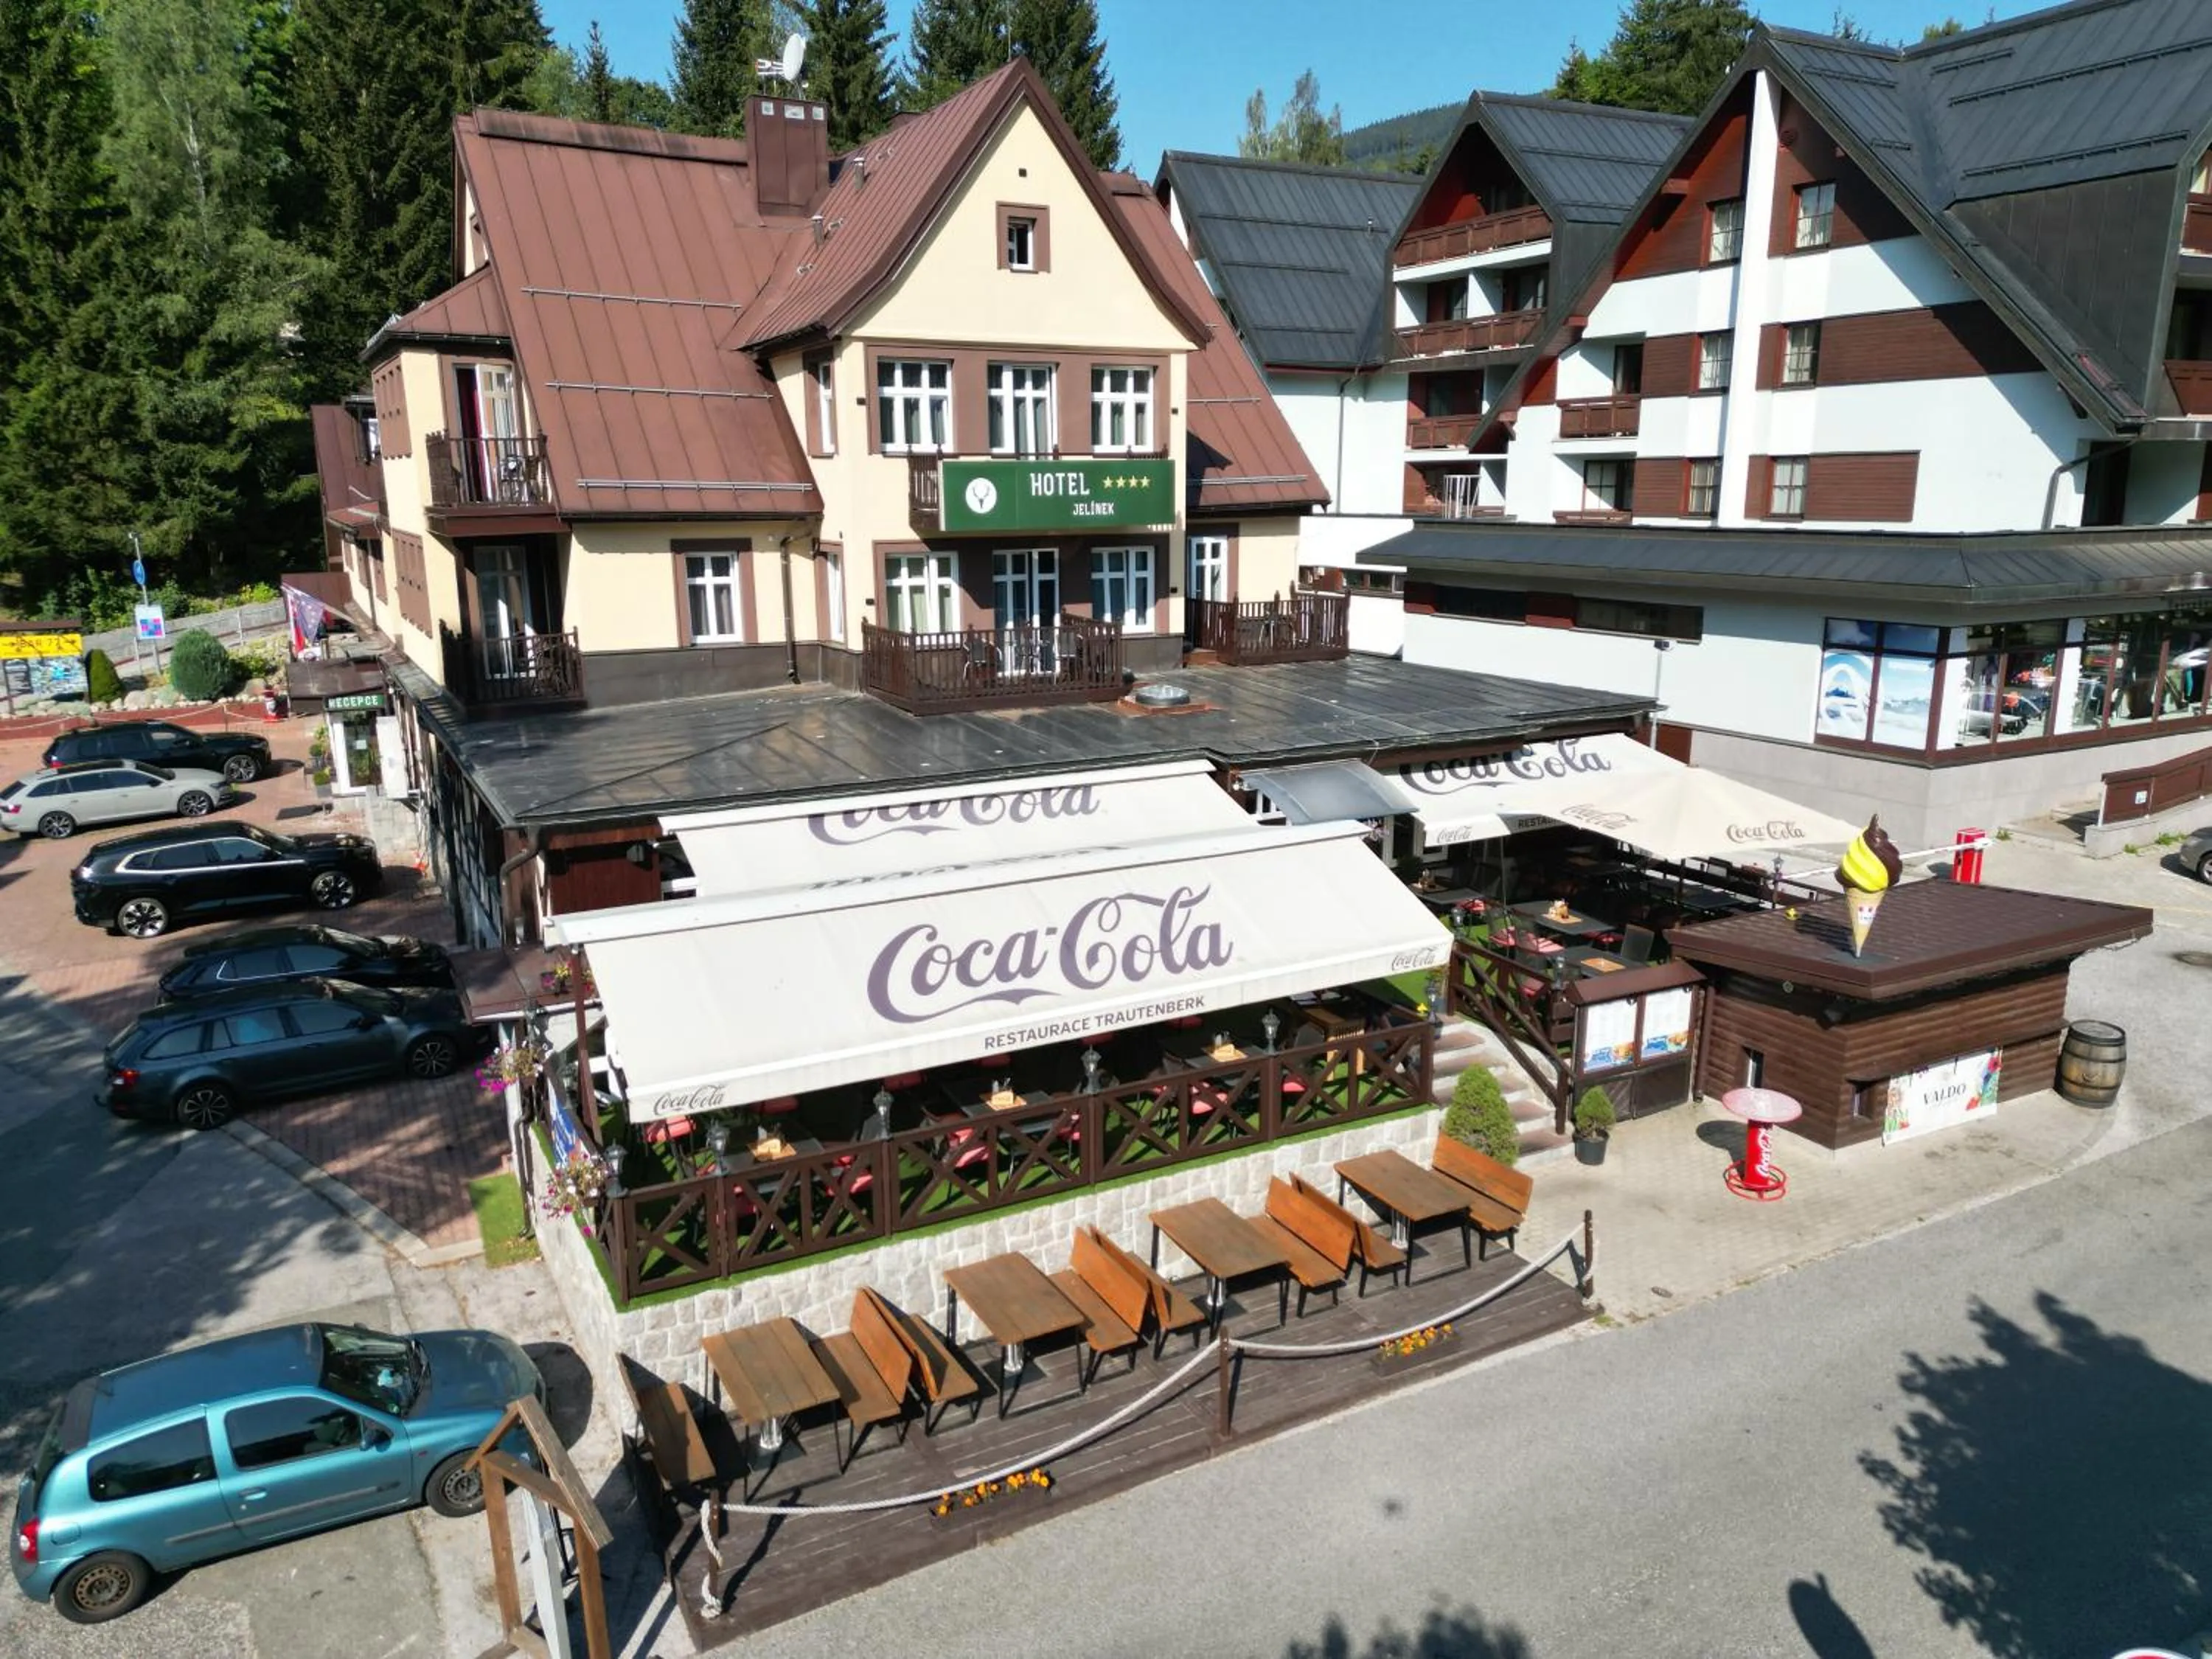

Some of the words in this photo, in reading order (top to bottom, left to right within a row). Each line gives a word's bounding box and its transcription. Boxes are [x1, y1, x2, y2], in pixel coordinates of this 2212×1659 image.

[1029, 472, 1091, 496] HOTEL
[1073, 500, 1115, 515] JELÍNEK
[867, 884, 1234, 1023] Coca-Cola
[984, 1018, 1091, 1050] RESTAURACE
[1095, 995, 1205, 1027] TRAUTENBERK
[1924, 1083, 1966, 1105] VALDO
